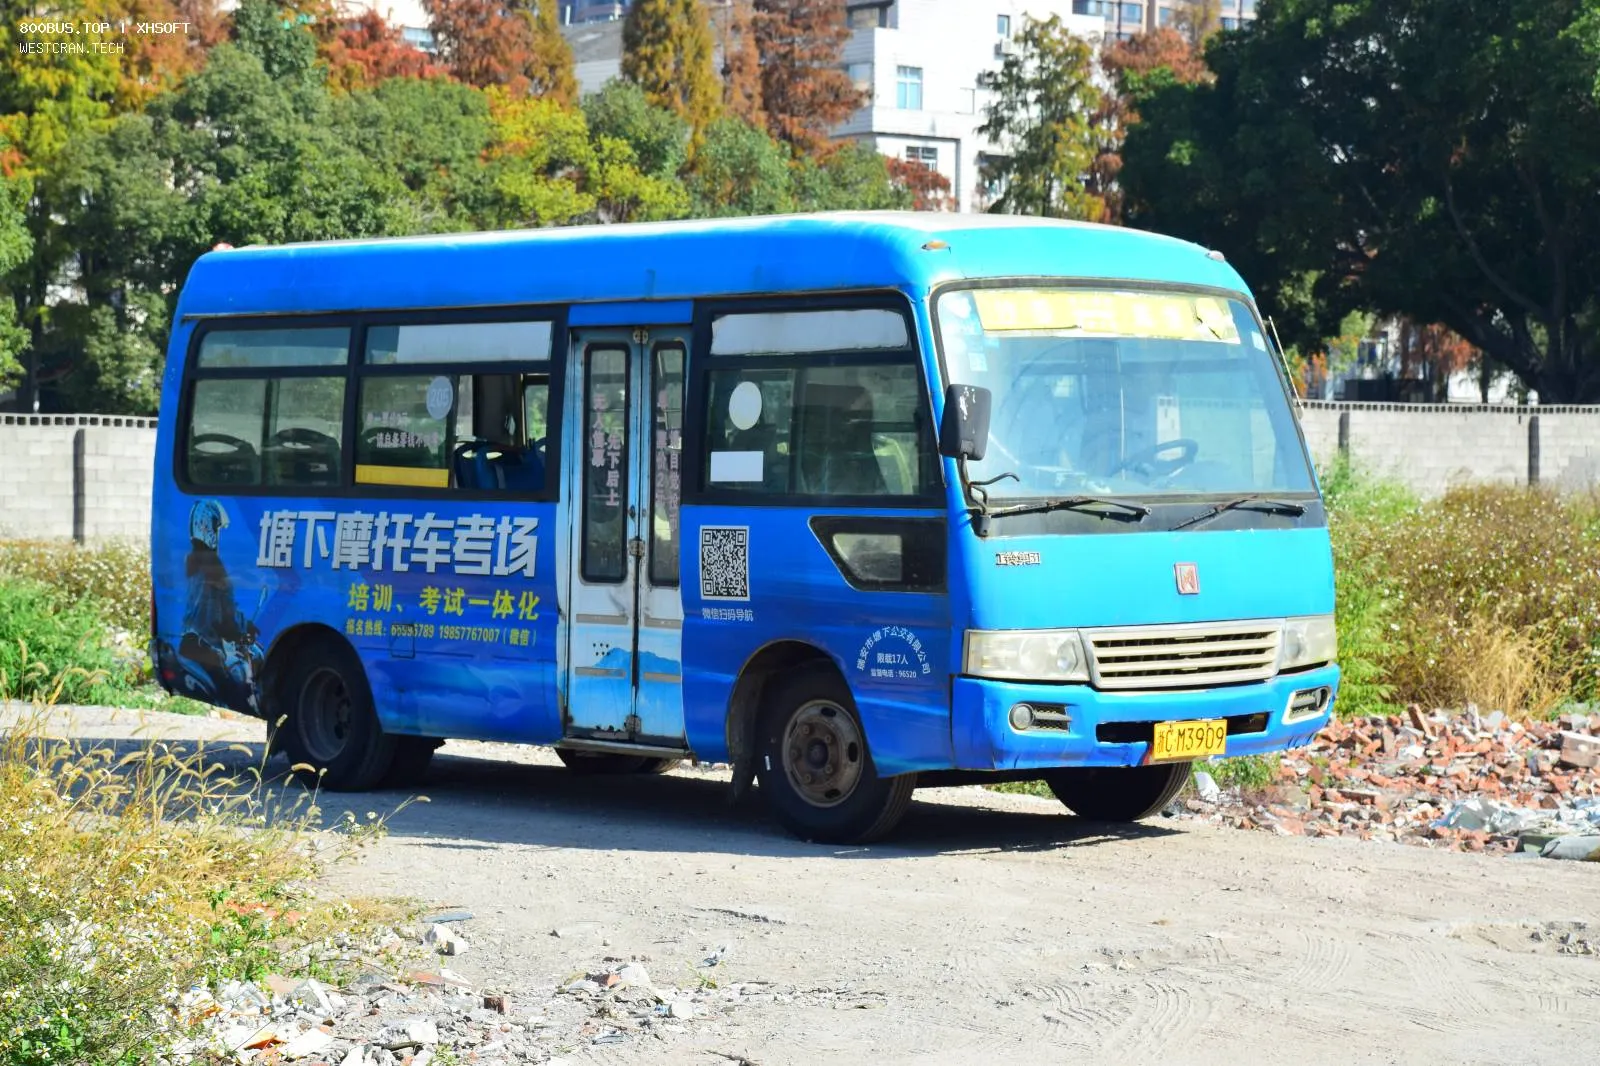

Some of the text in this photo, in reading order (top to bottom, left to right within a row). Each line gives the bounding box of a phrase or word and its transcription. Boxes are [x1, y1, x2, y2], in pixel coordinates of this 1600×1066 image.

[256, 509, 540, 578] 塘下摩托车考场
[346, 582, 541, 621] 培训、考试一体化
[702, 607, 754, 622] 微信扫码导航
